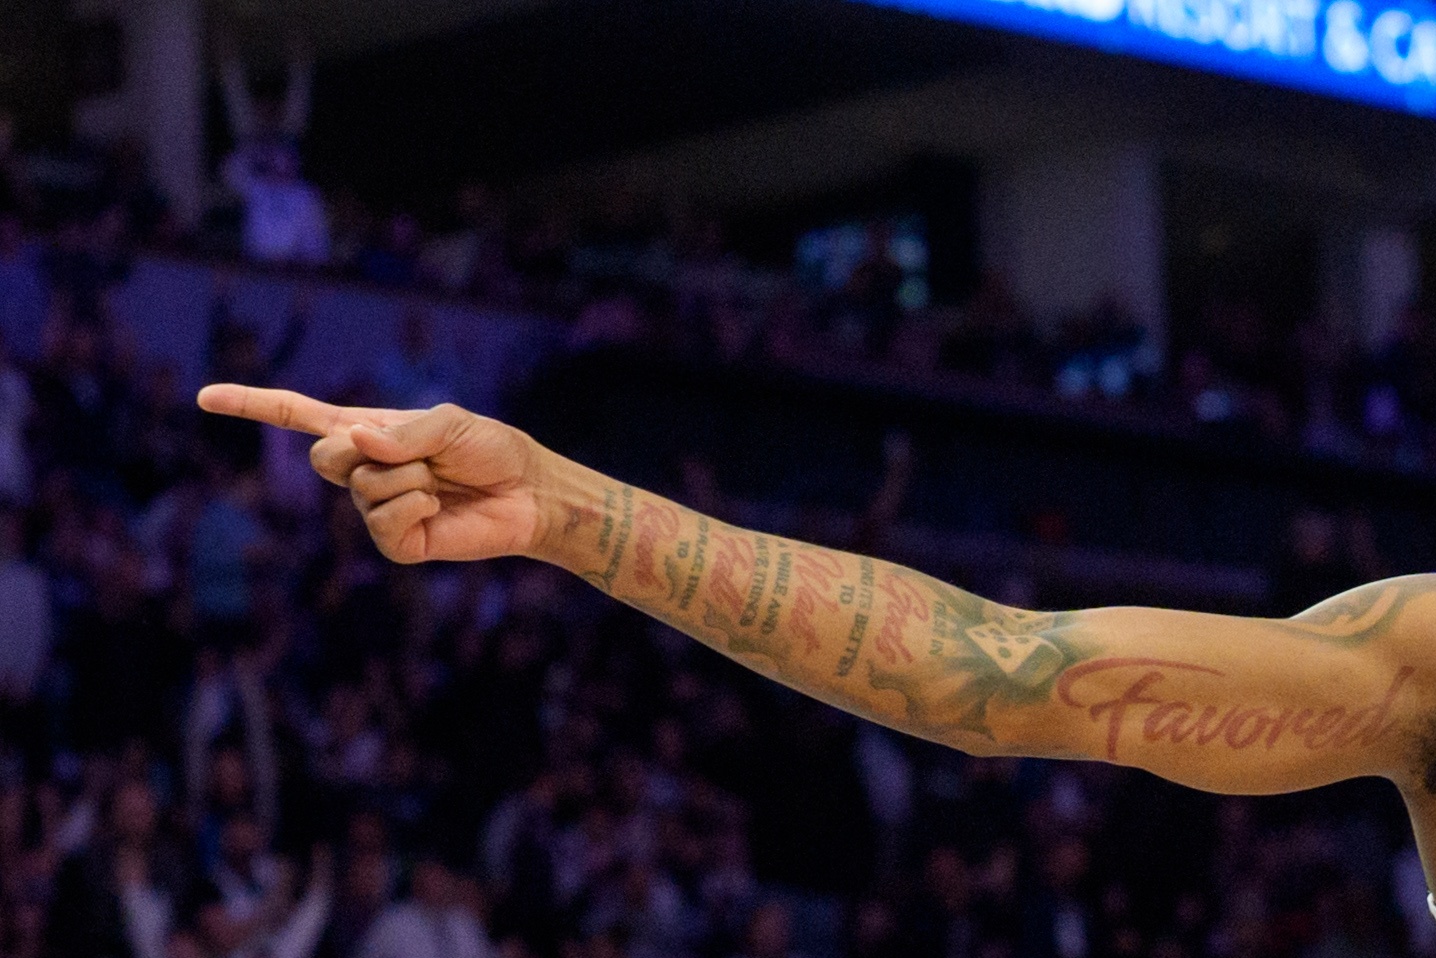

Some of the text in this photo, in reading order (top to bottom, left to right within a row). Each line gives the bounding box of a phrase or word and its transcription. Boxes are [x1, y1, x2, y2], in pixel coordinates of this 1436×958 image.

[772, 551, 792, 597] WHILE
[839, 584, 856, 605] TO
[1056, 657, 1416, 762] Favored
